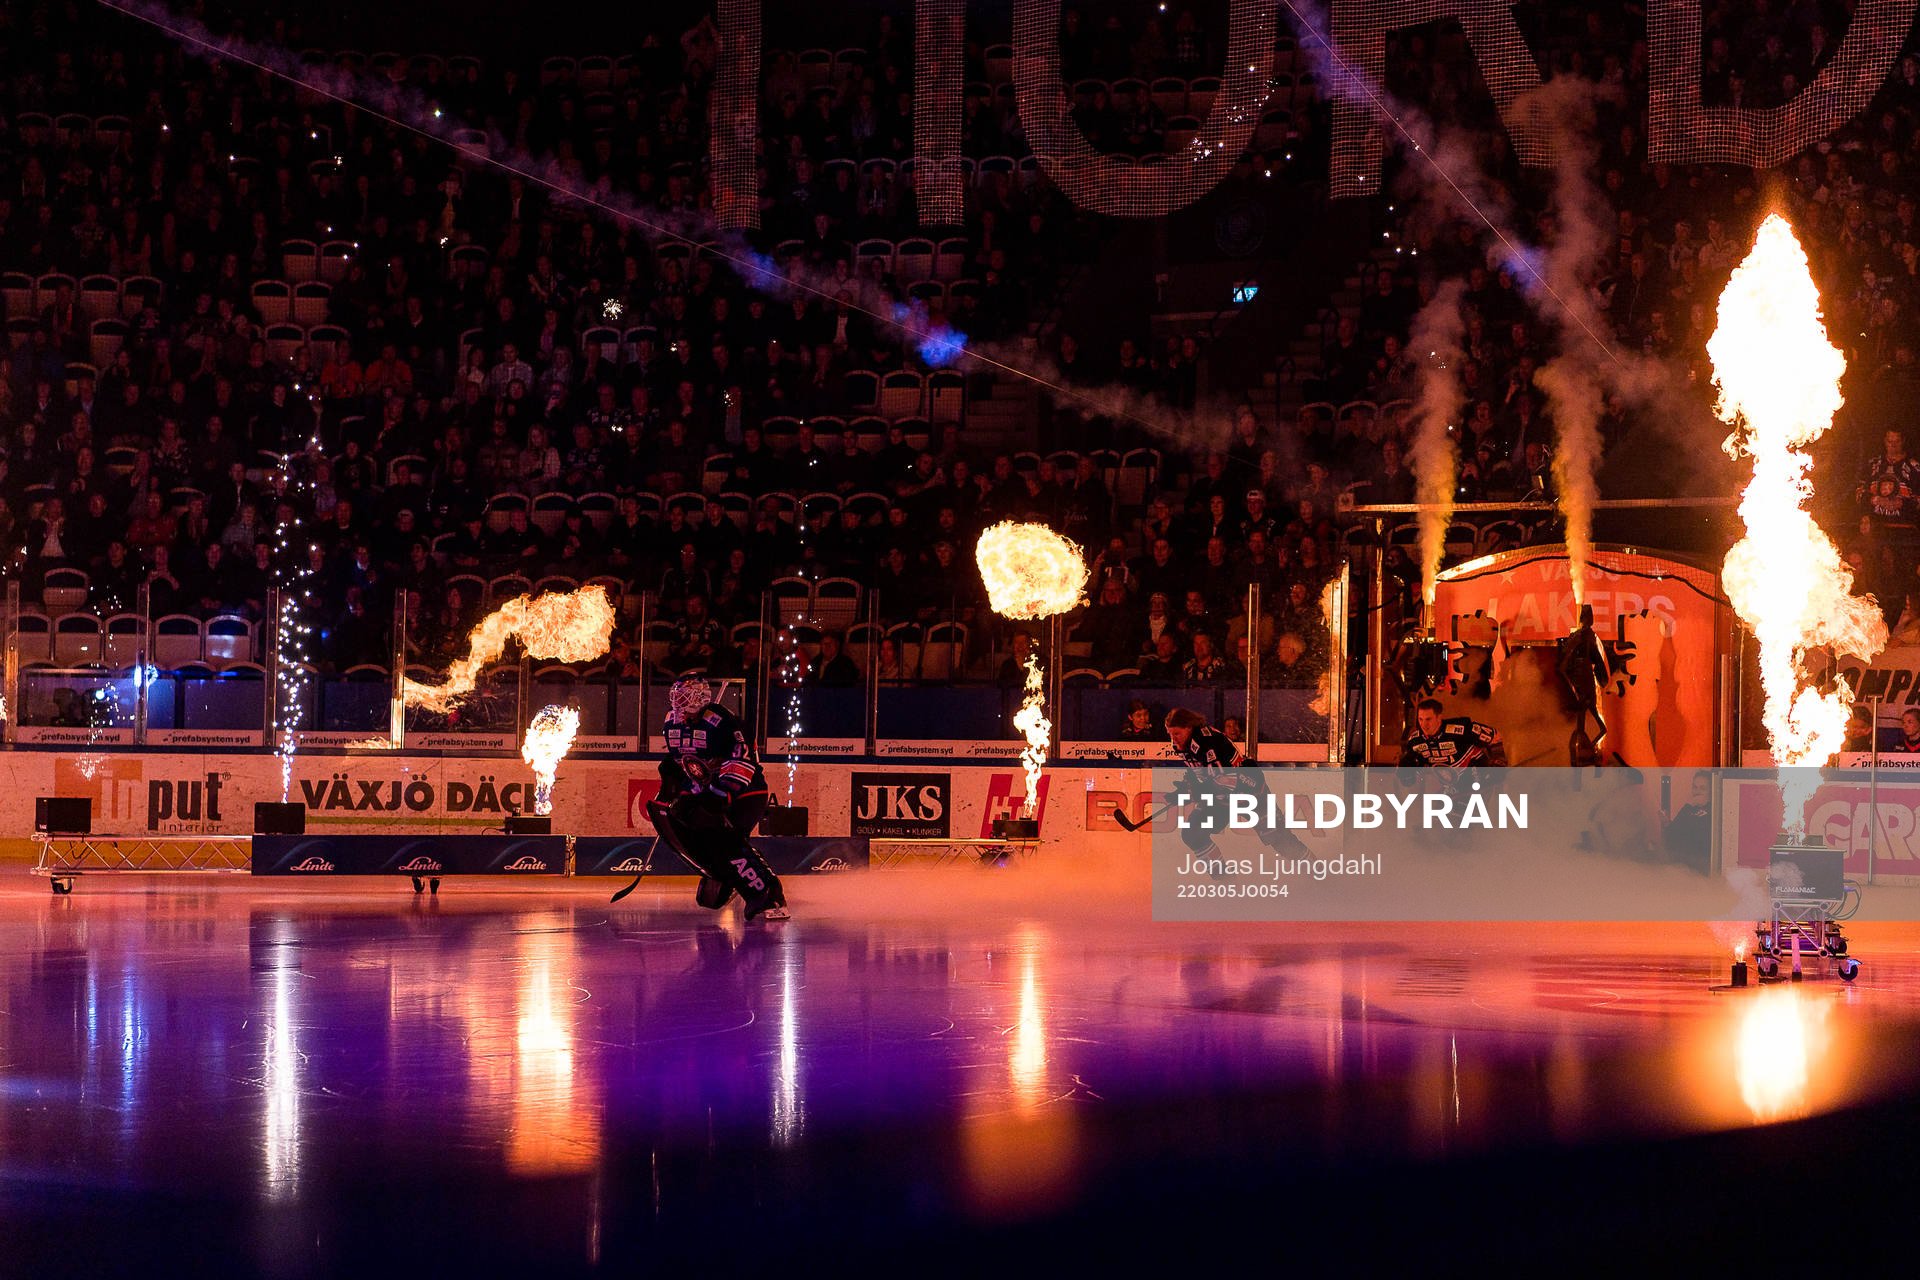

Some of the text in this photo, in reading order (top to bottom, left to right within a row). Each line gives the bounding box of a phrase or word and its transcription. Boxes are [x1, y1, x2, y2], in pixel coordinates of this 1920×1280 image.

[1539, 560, 1622, 582] VÄJÖ
[104, 735, 121, 743] syd
[172, 734, 251, 744] prefabsystem syd
[427, 737, 504, 748] prefabsystem syd
[612, 742, 626, 750] syd
[839, 744, 854, 753] syd
[888, 745, 954, 755] prefabsystem syd
[974, 745, 1024, 756] prefabsyste
[1132, 748, 1145, 757] syd
[300, 772, 435, 812] VÄXJÖ
[857, 784, 943, 822] JKS
[163, 822, 222, 833] interiör
[856, 826, 942, 836] GOLV KAKEL KLINKER
[290, 856, 336, 871] Linde
[398, 856, 442, 871] Linde
[503, 855, 547, 871] Linde
[730, 857, 766, 892] APP
